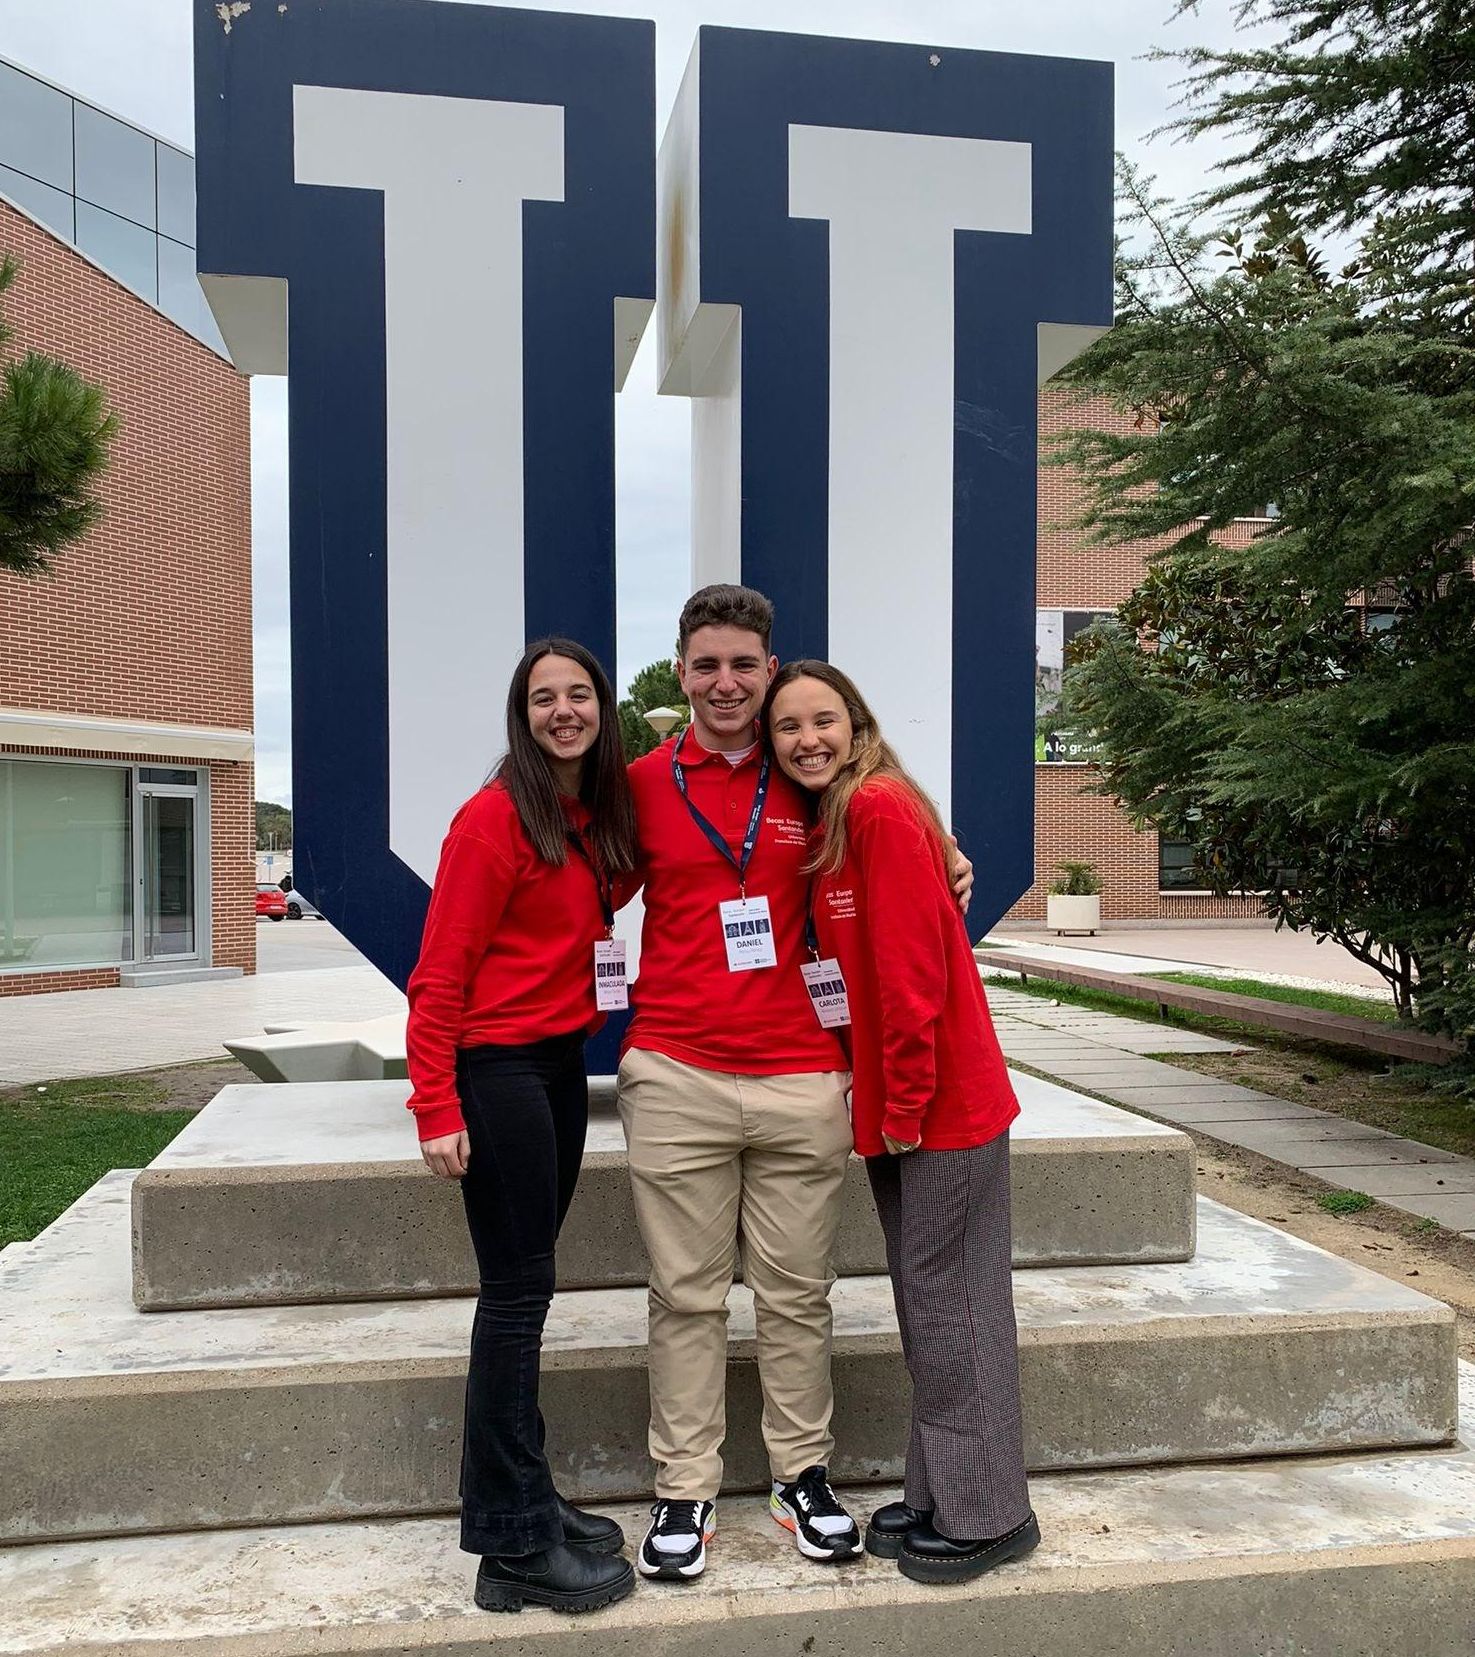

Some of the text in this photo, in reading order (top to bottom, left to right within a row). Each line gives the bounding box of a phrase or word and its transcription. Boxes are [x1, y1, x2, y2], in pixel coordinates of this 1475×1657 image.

[1043, 741, 1053, 752] A
[1055, 741, 1067, 752] lo
[736, 939, 763, 948] DANIEL
[818, 998, 845, 1007] CARLOTA
